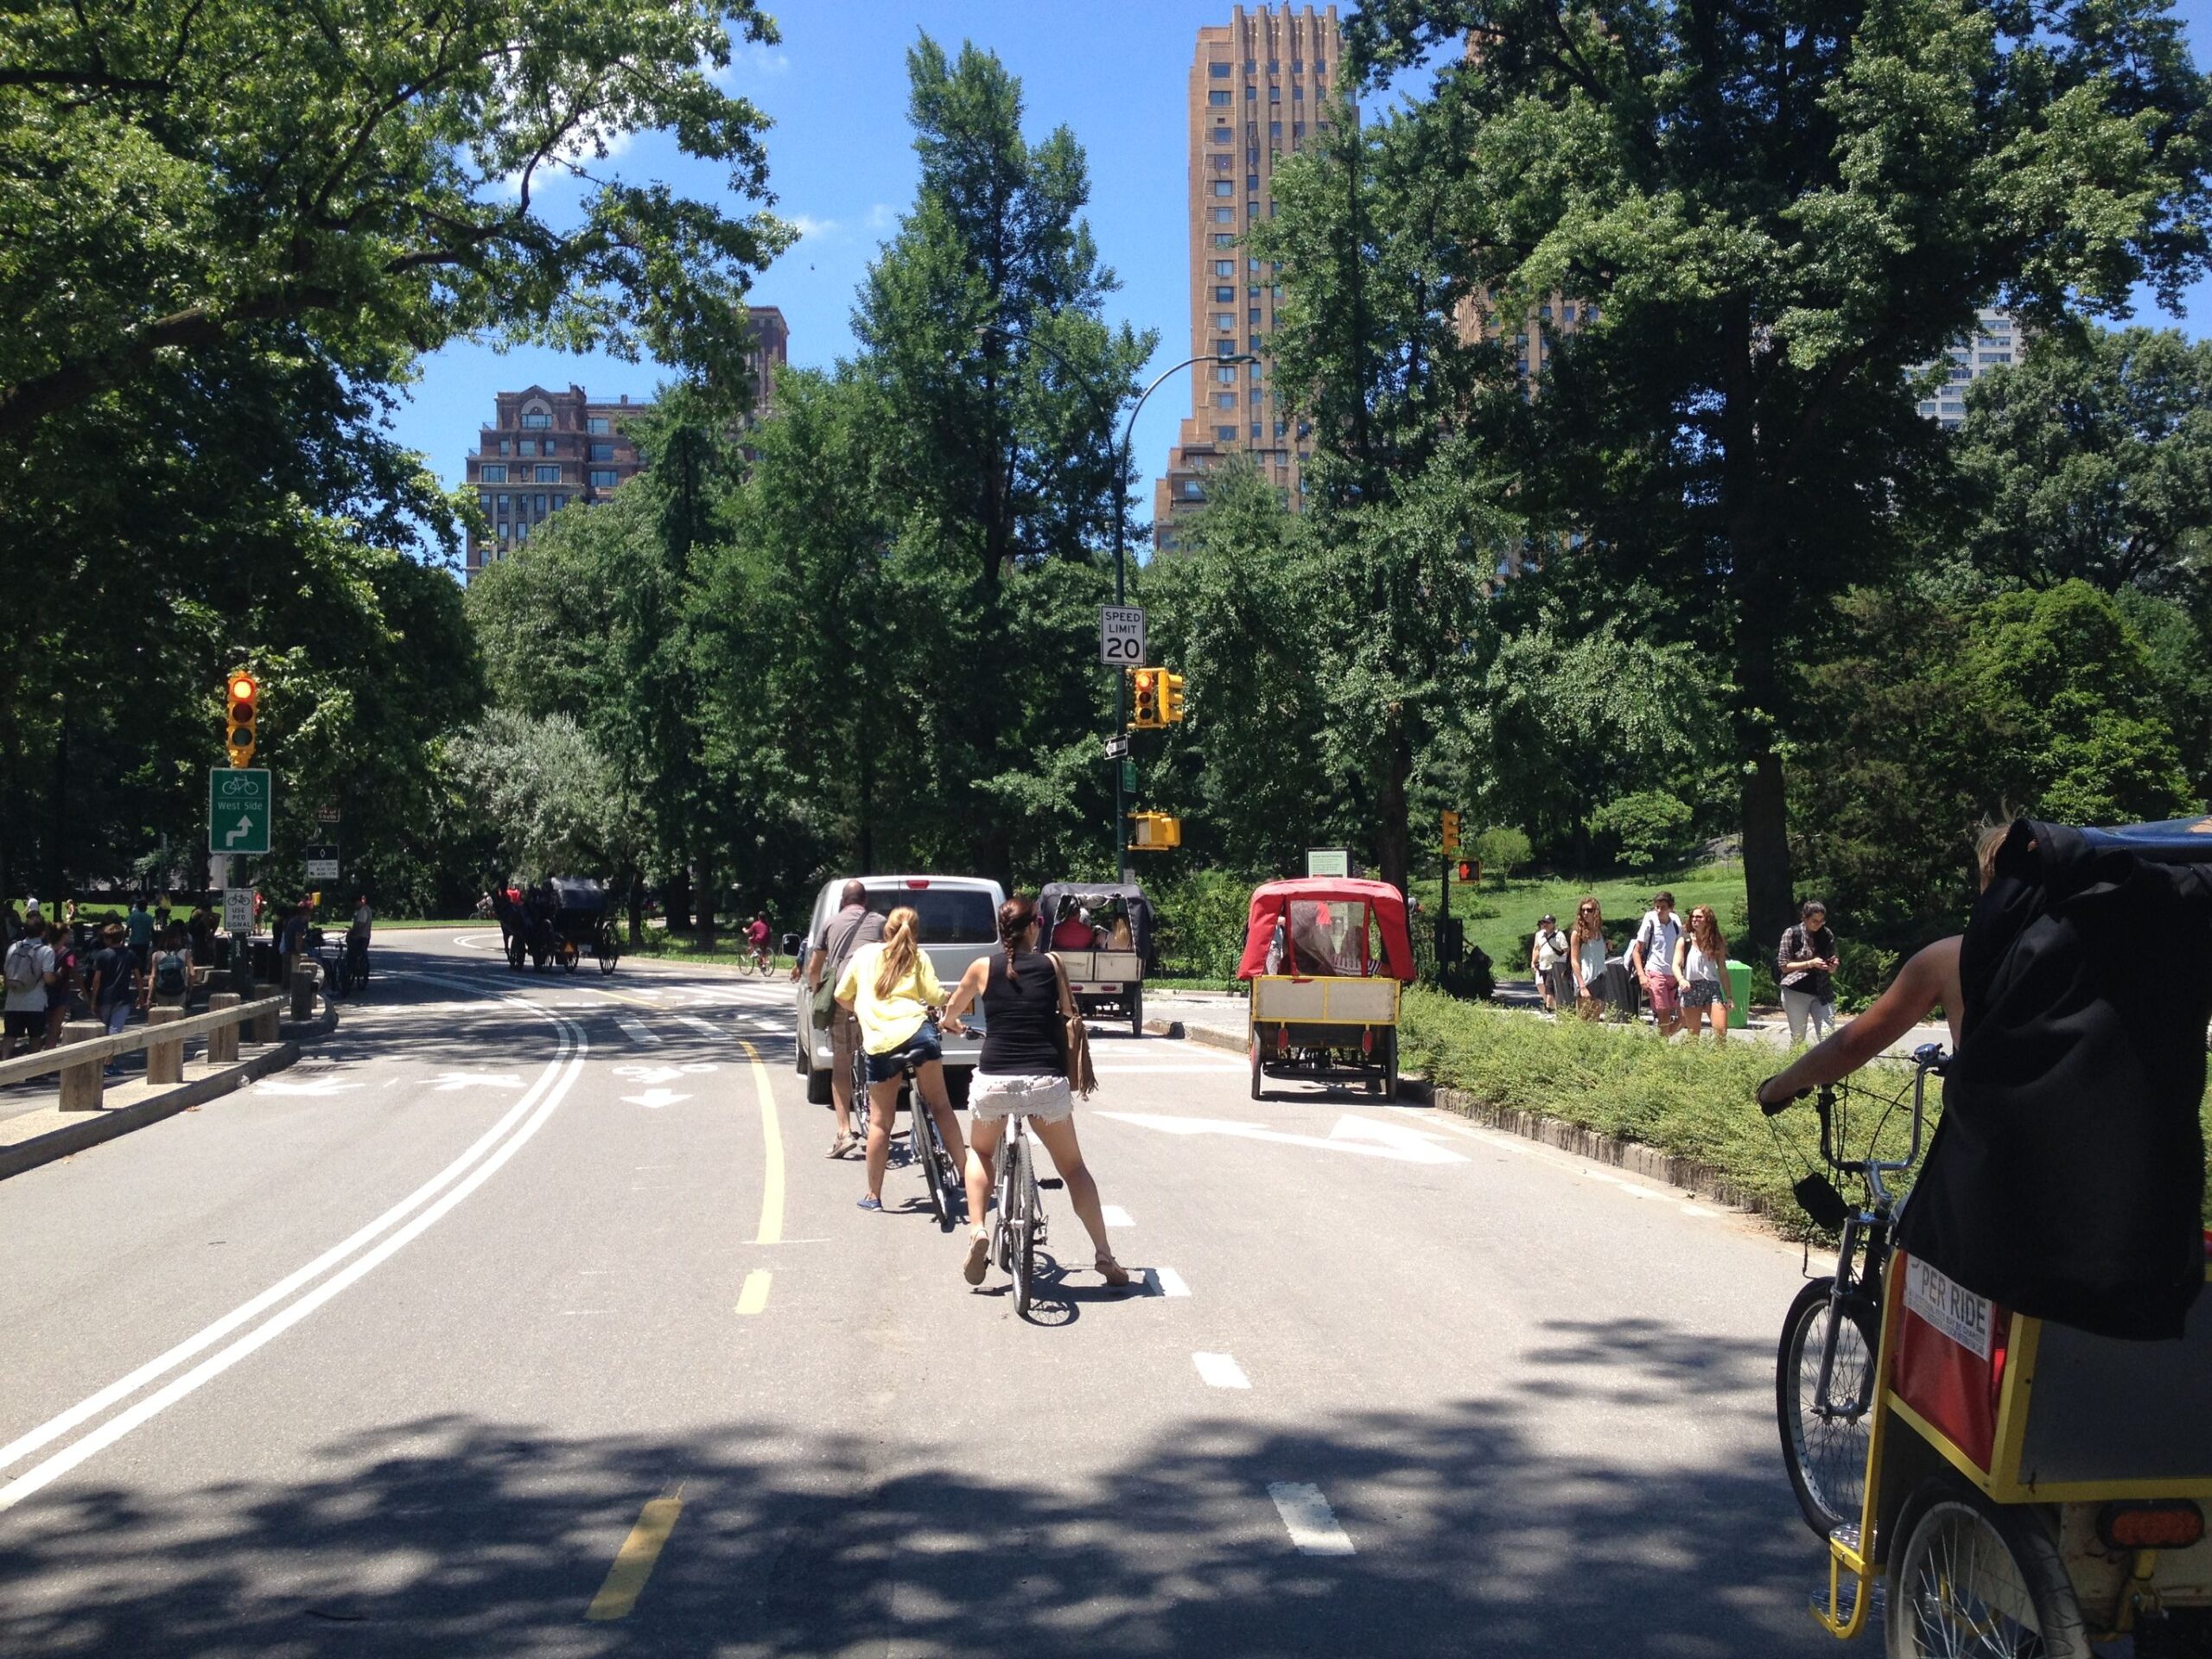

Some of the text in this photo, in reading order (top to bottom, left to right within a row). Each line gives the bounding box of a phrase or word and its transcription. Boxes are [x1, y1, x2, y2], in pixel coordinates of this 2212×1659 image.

[1105, 611, 1141, 622] SPEED
[1109, 624, 1136, 634] LIMIT
[1107, 638, 1140, 658] 20
[218, 801, 263, 810] West Side
[1922, 1265, 1946, 1311] PER
[1950, 1284, 1986, 1335] RIDE
